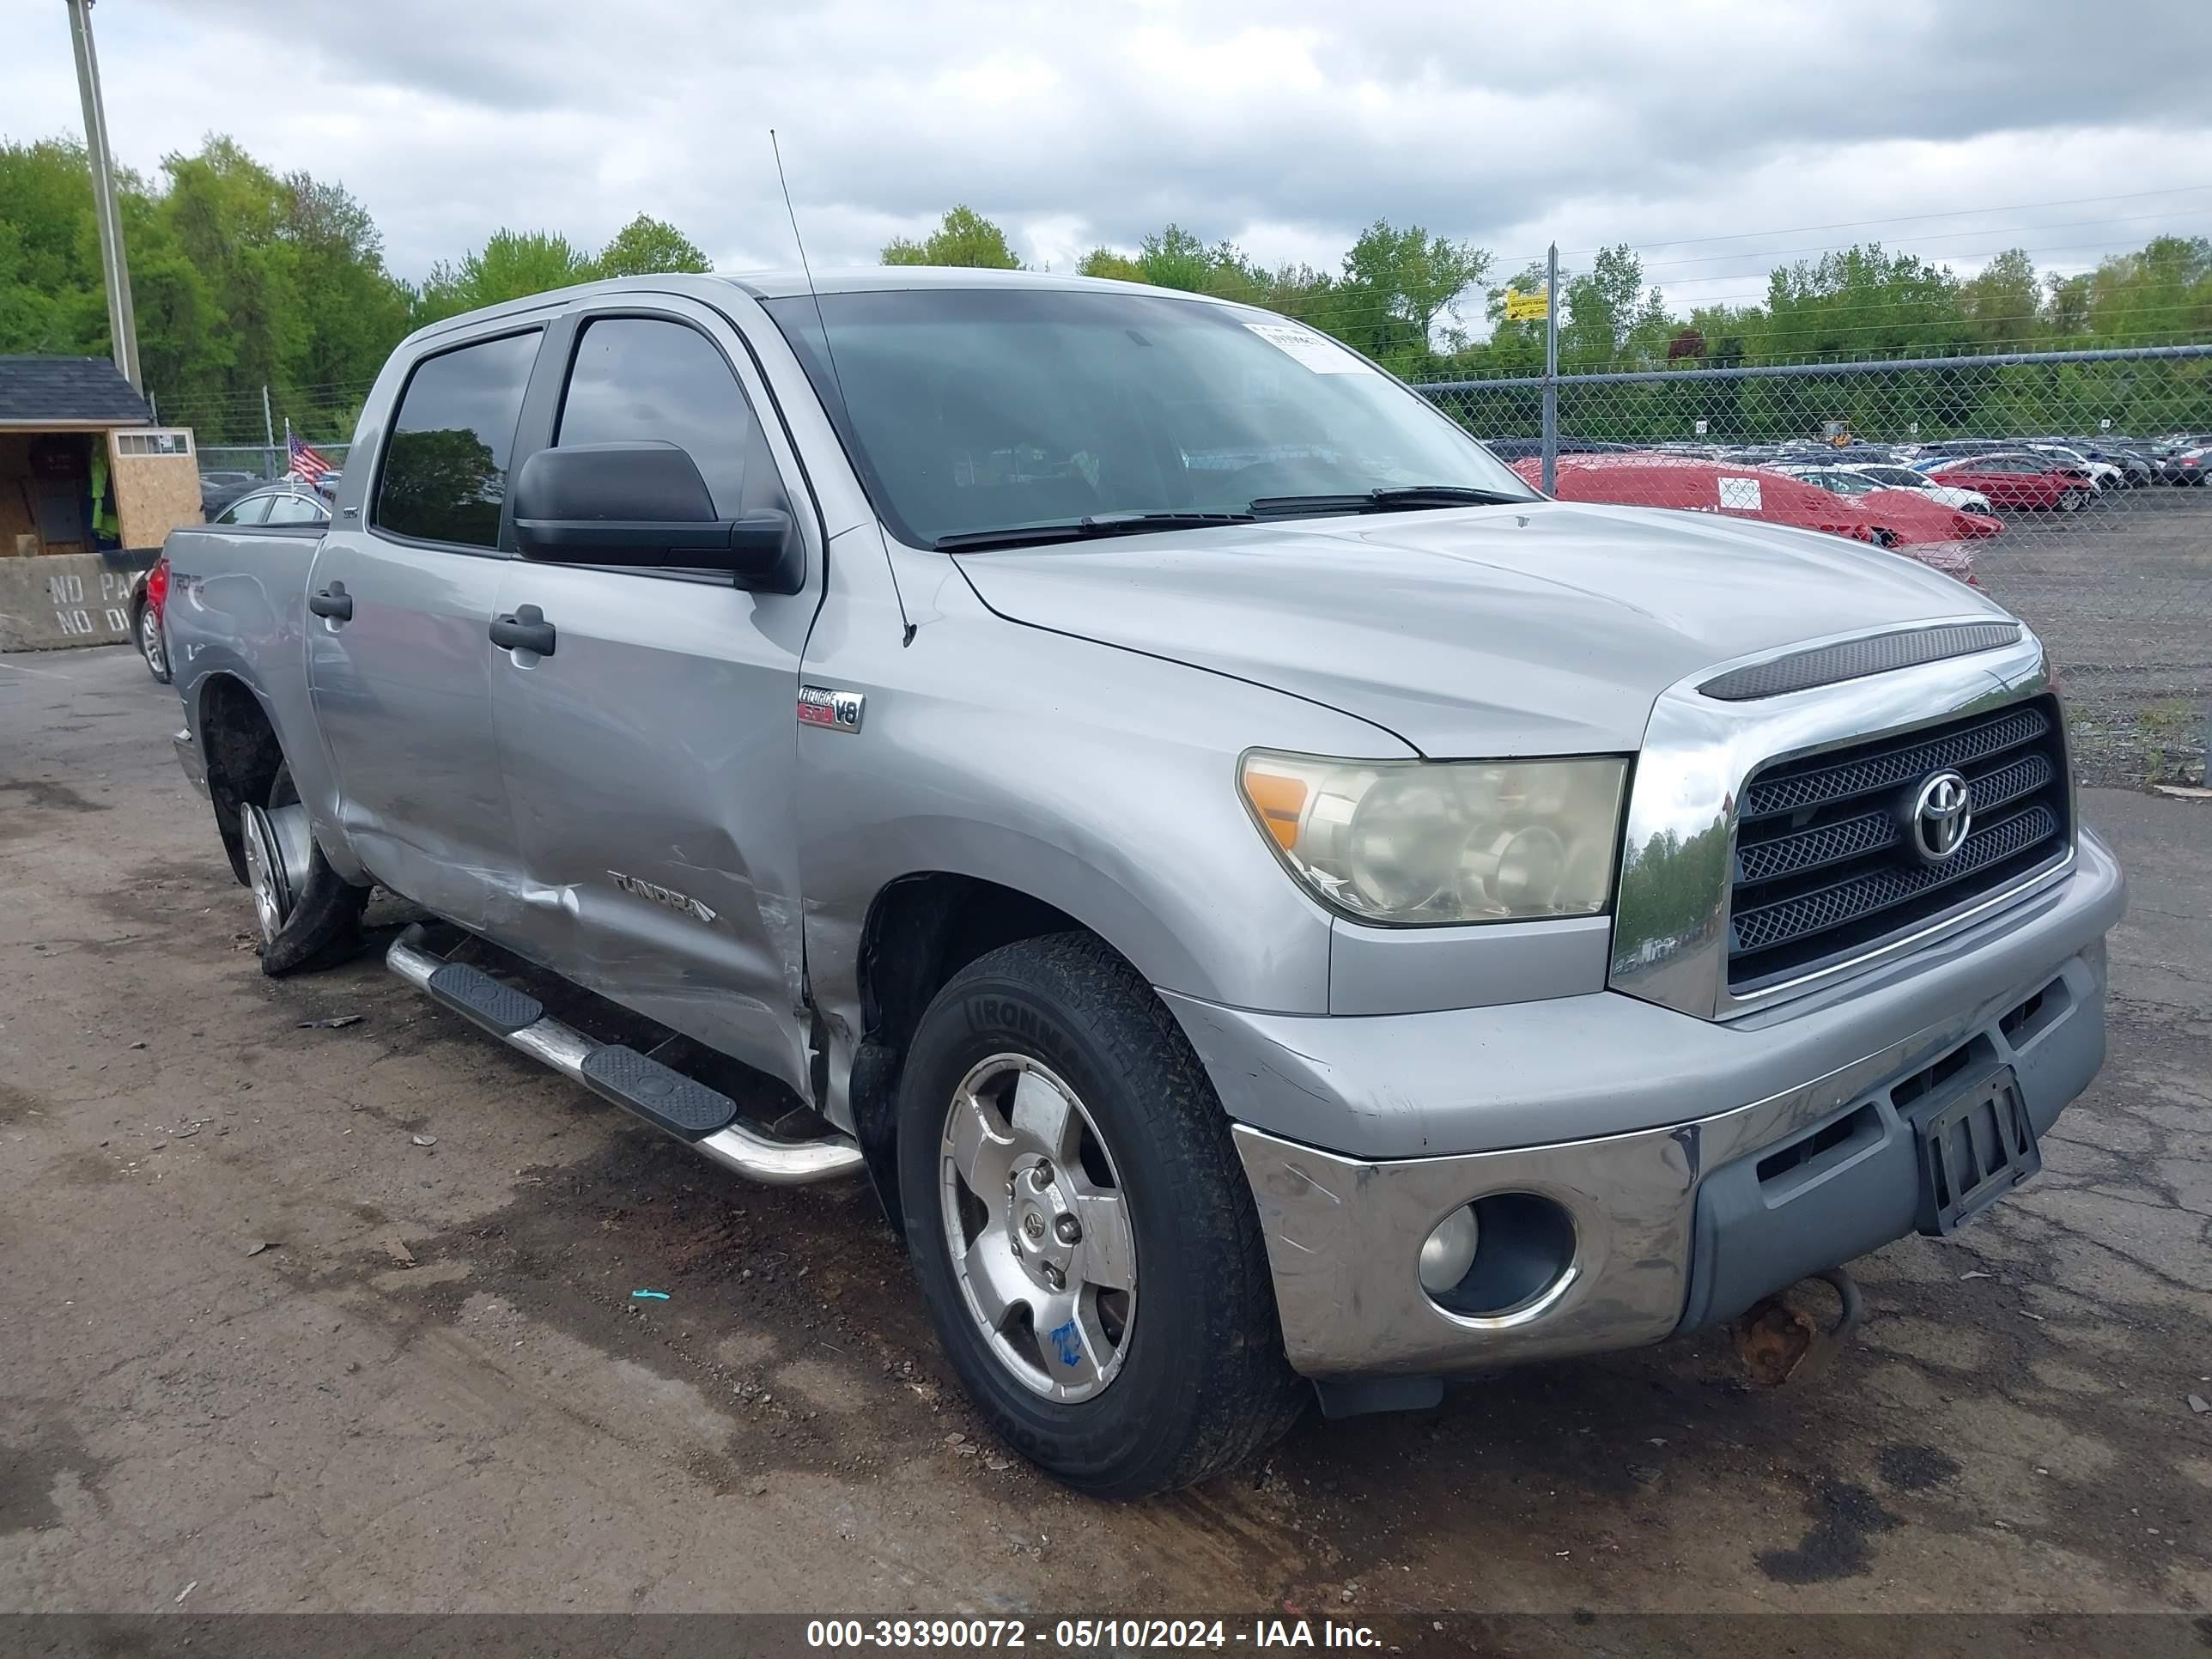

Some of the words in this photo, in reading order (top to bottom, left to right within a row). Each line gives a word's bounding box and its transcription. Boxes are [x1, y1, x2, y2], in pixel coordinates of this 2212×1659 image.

[51, 575, 83, 604] NO
[56, 610, 93, 635] NO
[606, 869, 717, 923] TUNDRA
